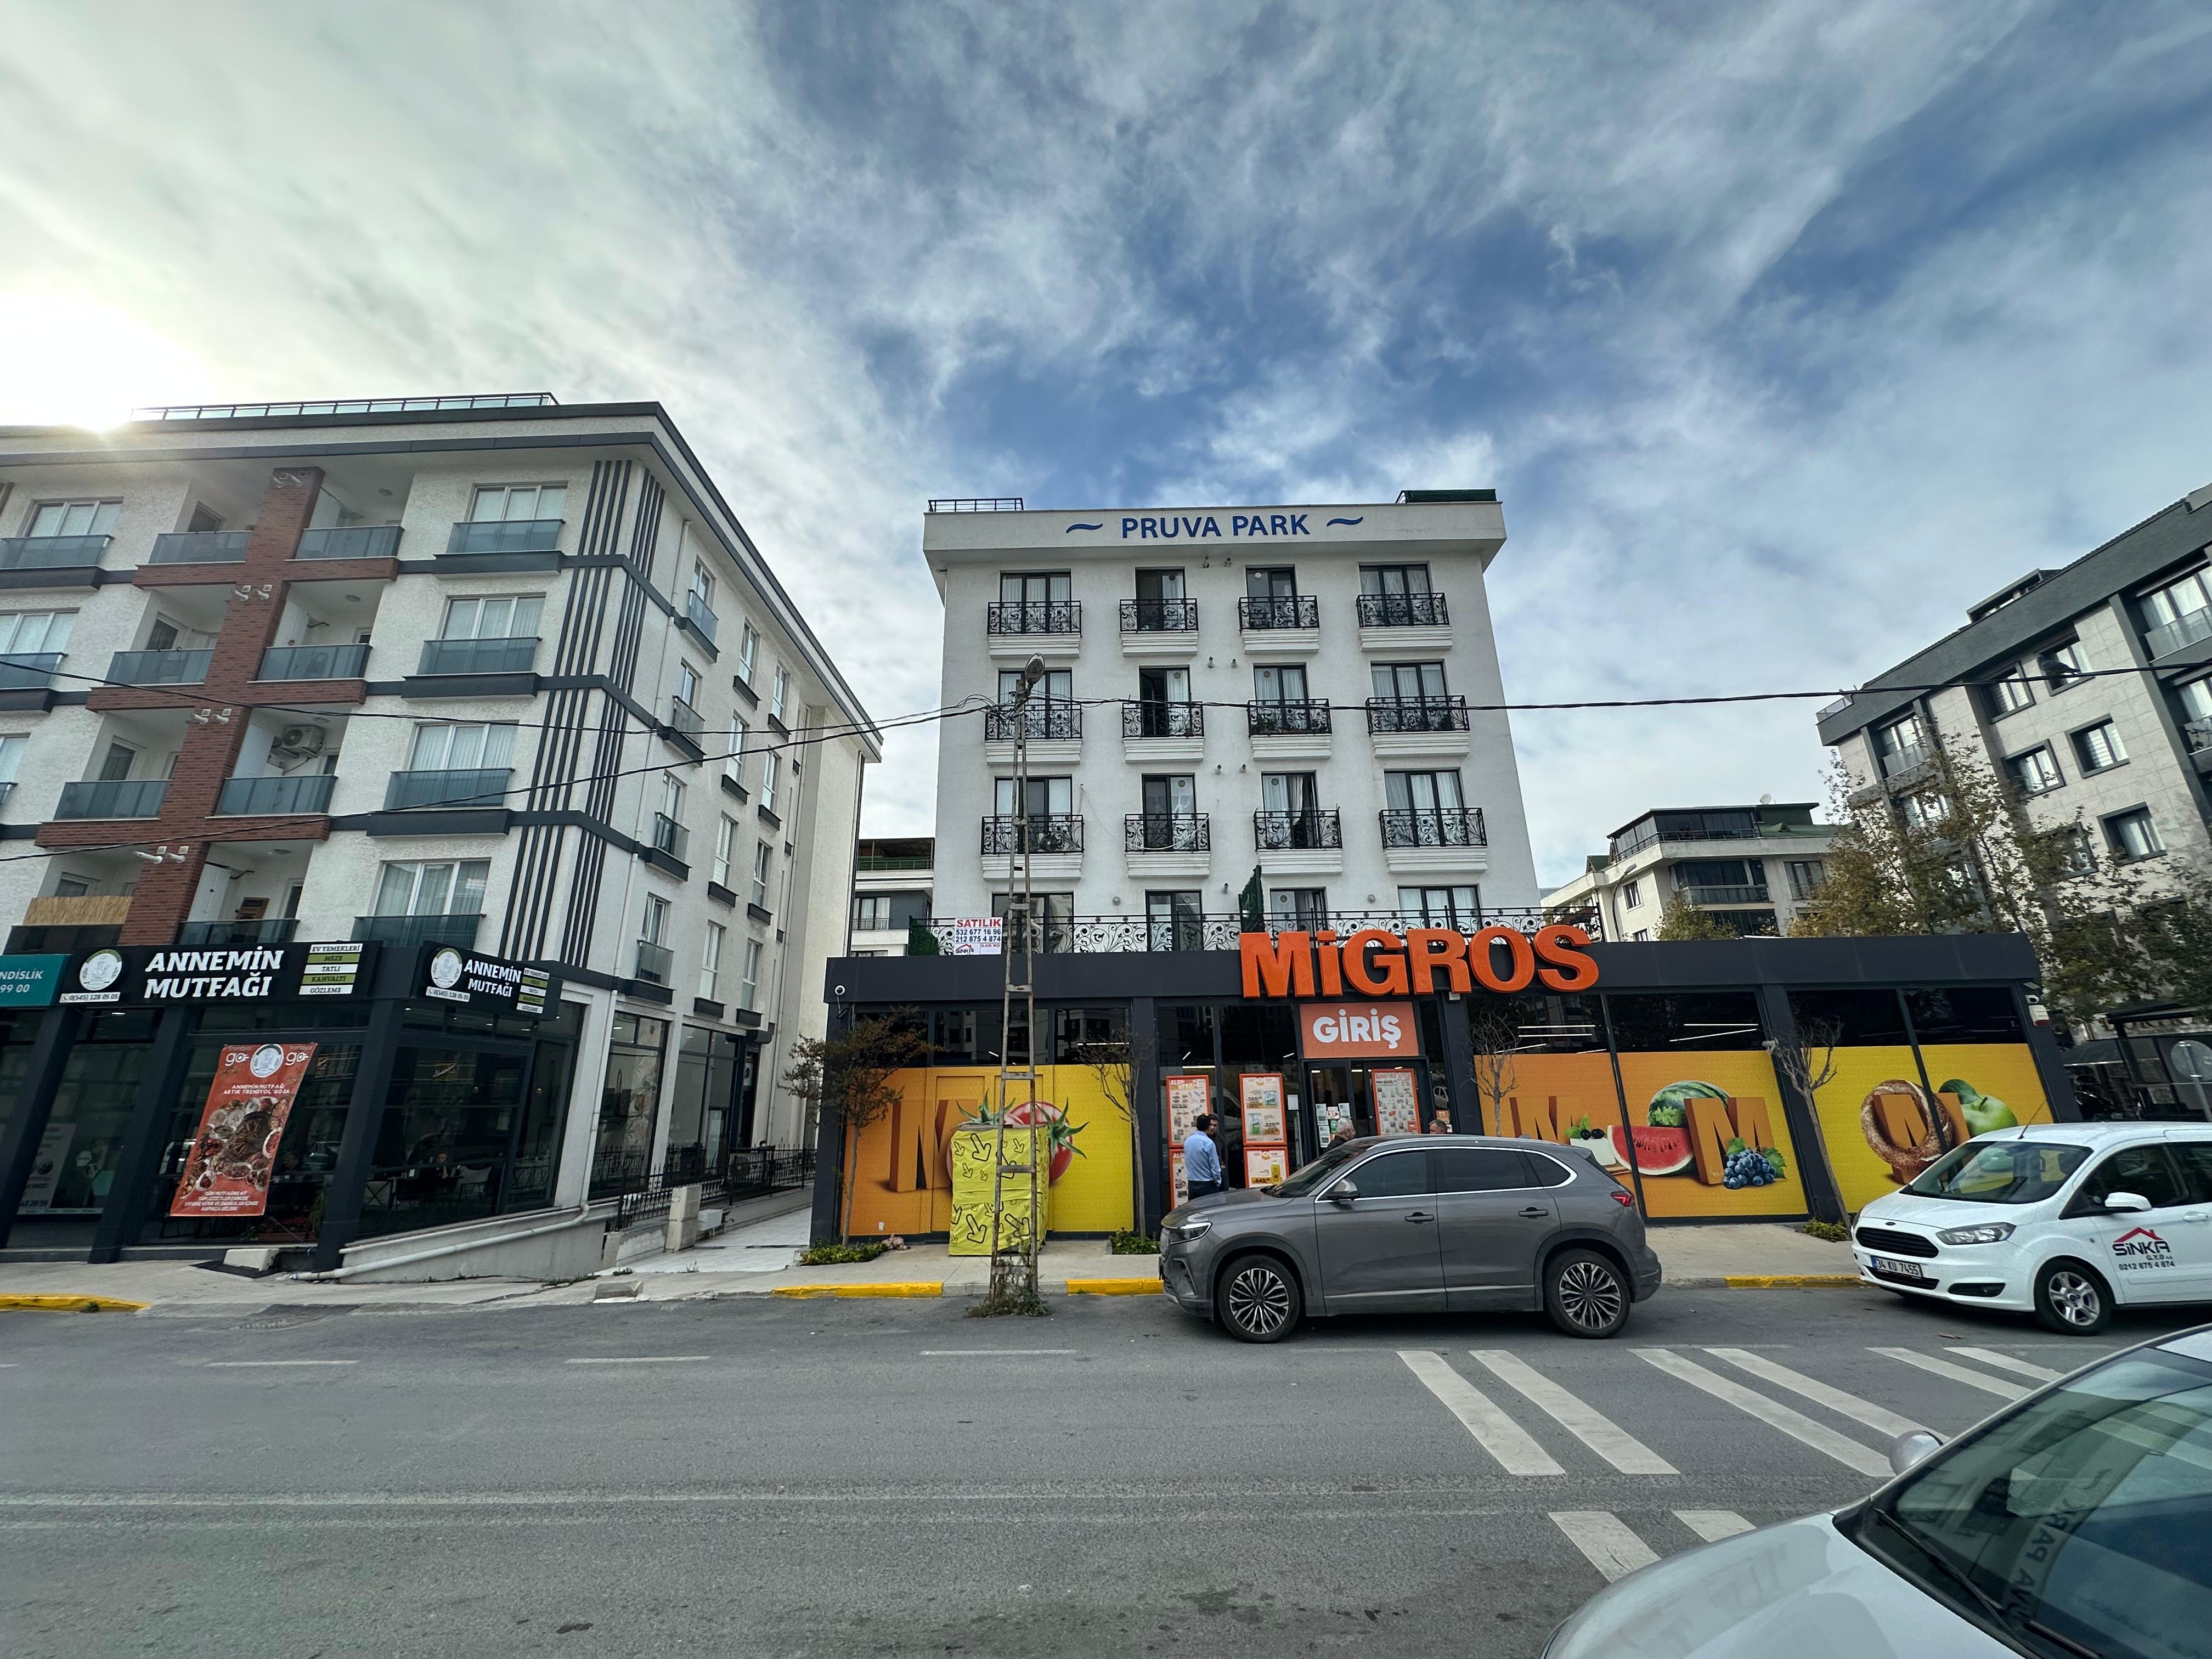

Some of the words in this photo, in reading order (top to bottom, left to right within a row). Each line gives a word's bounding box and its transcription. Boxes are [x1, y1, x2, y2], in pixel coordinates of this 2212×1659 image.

[1122, 516, 1221, 539] PRUVA
[1232, 514, 1310, 536] PARK
[956, 918, 1001, 928] SATILIK
[145, 946, 284, 972] ANNEMİN
[464, 960, 522, 984] ANNEMİN
[16, 984, 30, 993] 00
[144, 972, 273, 998] MUTFAĞI
[467, 978, 512, 997] MUTFAĞI
[1313, 1008, 1402, 1049] GİRİŞ
[225, 1053, 249, 1066] go
[285, 1052, 309, 1065] go
[1876, 1259, 1886, 1269] 34
[1899, 1262, 1918, 1276] 7455
